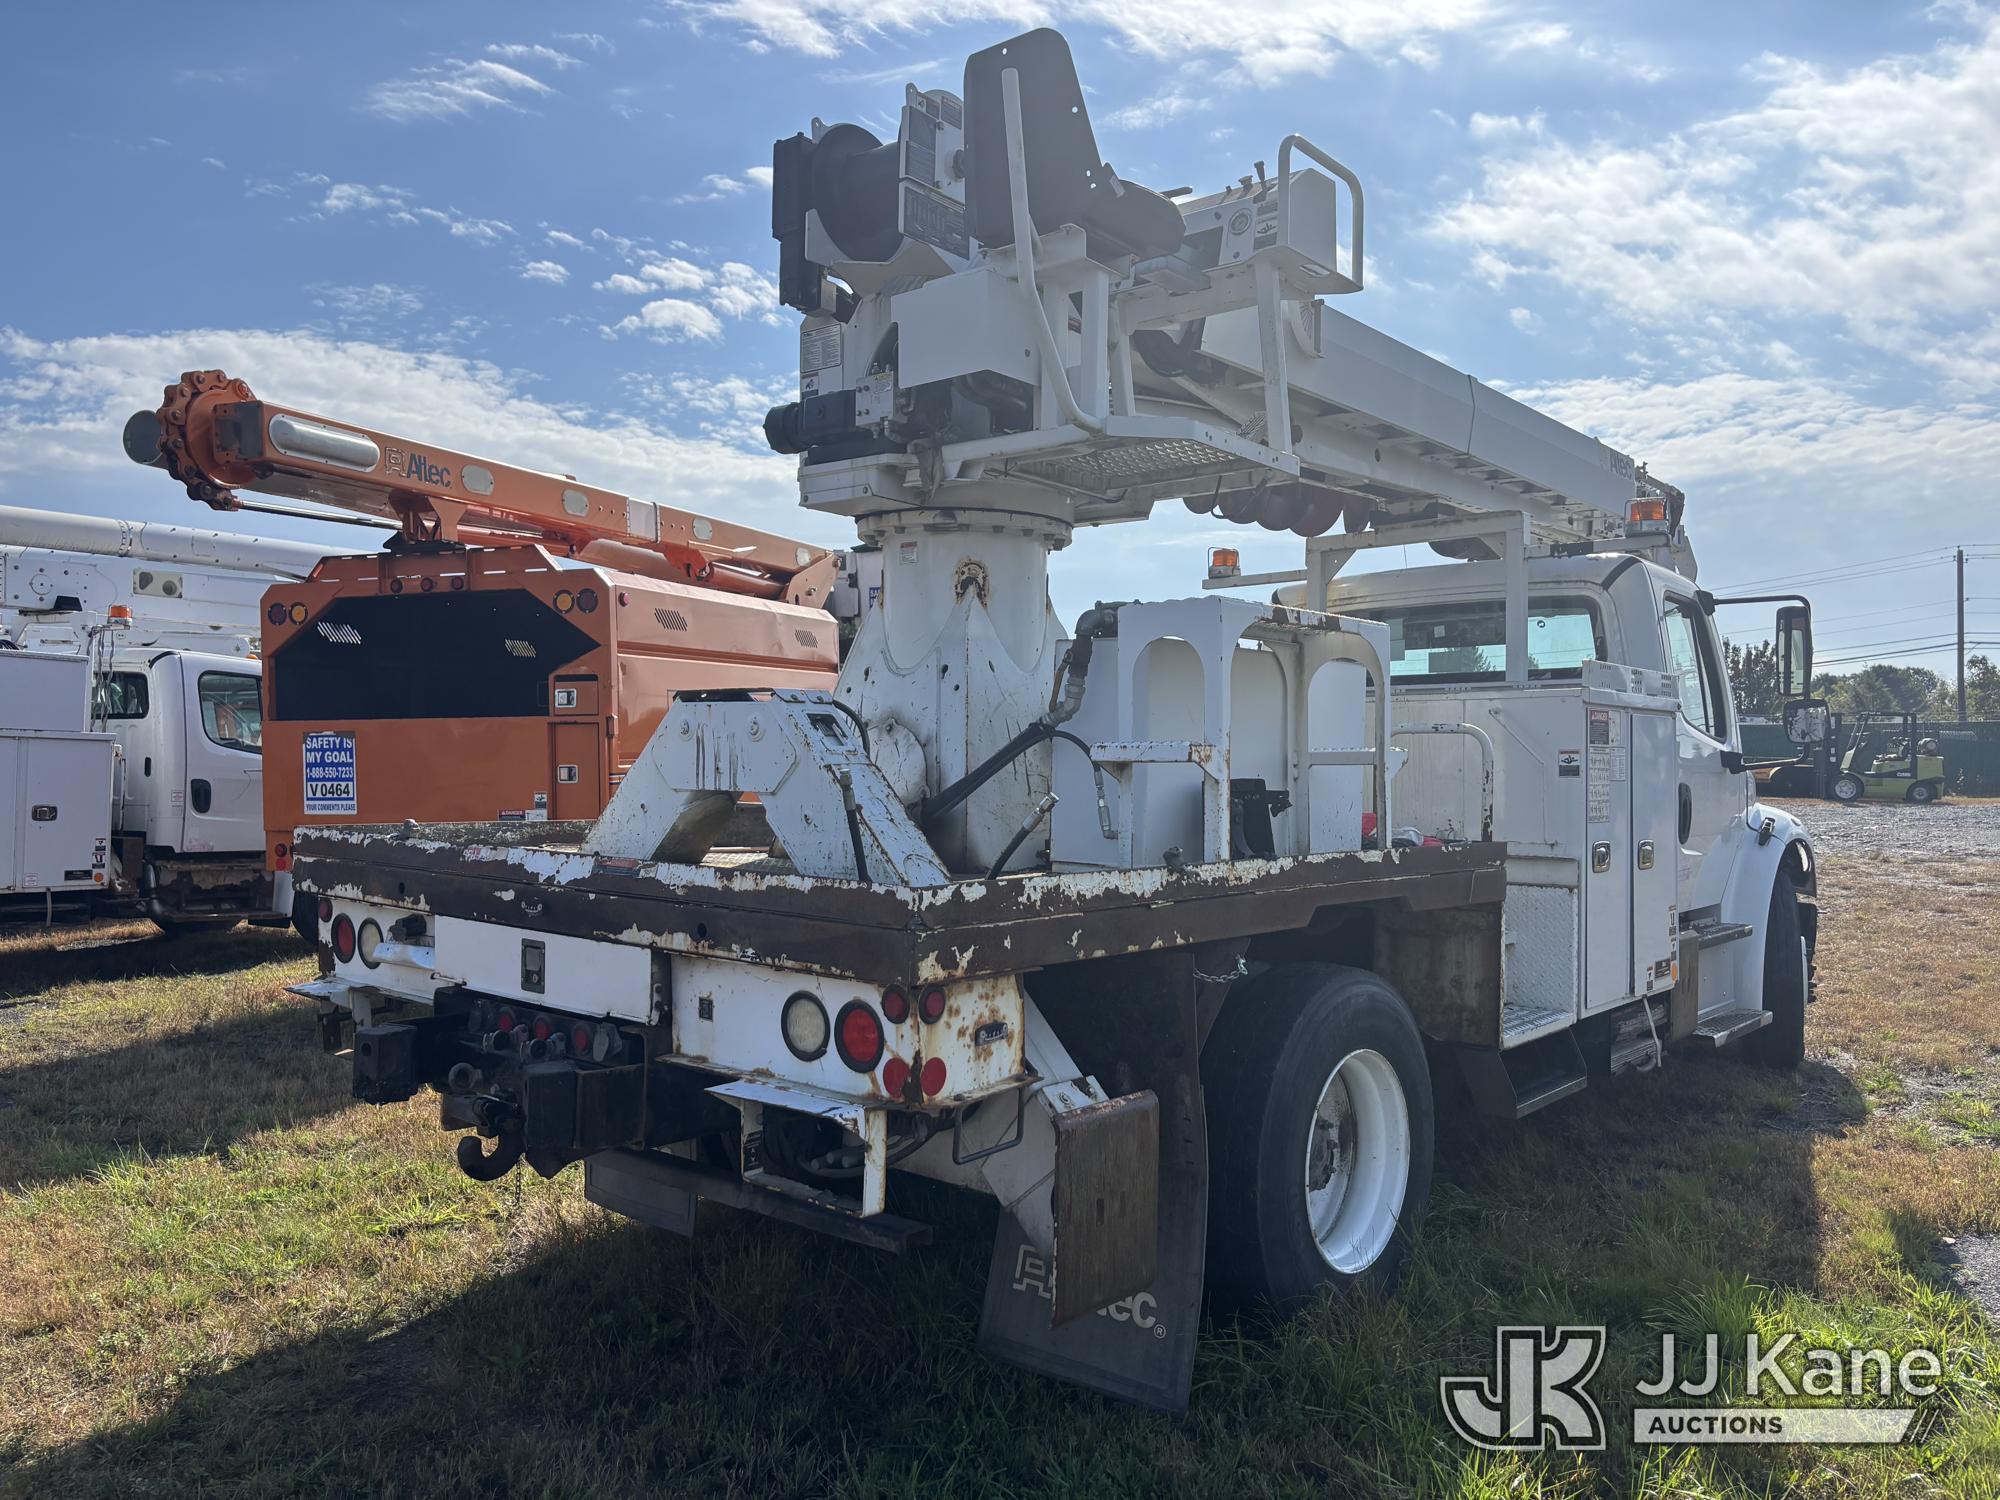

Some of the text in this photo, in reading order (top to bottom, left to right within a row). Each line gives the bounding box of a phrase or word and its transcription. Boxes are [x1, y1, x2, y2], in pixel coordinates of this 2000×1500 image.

[406, 452, 451, 488] Altec
[306, 737, 353, 749] SAFETY IS
[306, 751, 353, 763] MY GOAL
[306, 766, 354, 779] 1-888-550-7233
[309, 783, 351, 797] V 0464
[340, 803, 356, 811] PLEASE
